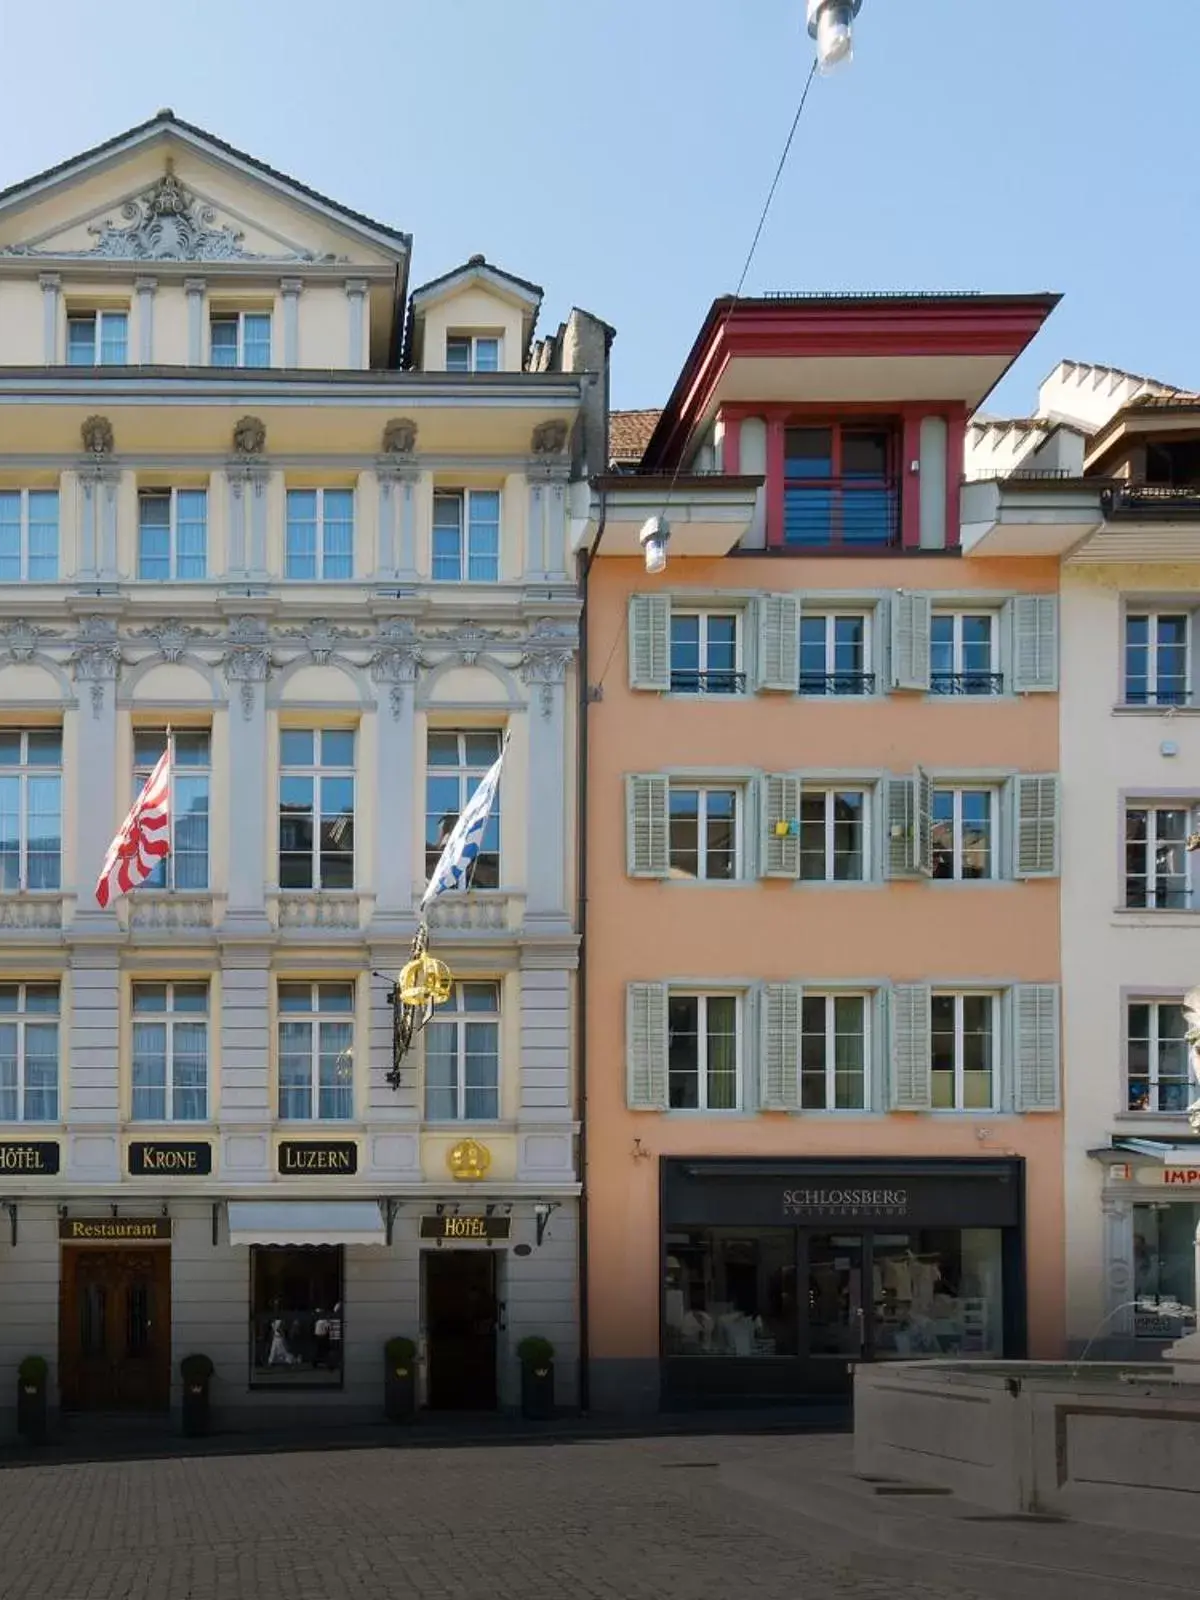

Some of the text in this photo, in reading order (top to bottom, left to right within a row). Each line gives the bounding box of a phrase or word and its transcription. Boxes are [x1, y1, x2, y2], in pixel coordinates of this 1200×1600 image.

[143, 1147, 197, 1169] KRONE
[286, 1147, 350, 1169] LUZERN
[1164, 1170, 1200, 1184] IMP
[783, 1189, 907, 1204] SCHLOSSBERG
[72, 1221, 157, 1237] Restaurant
